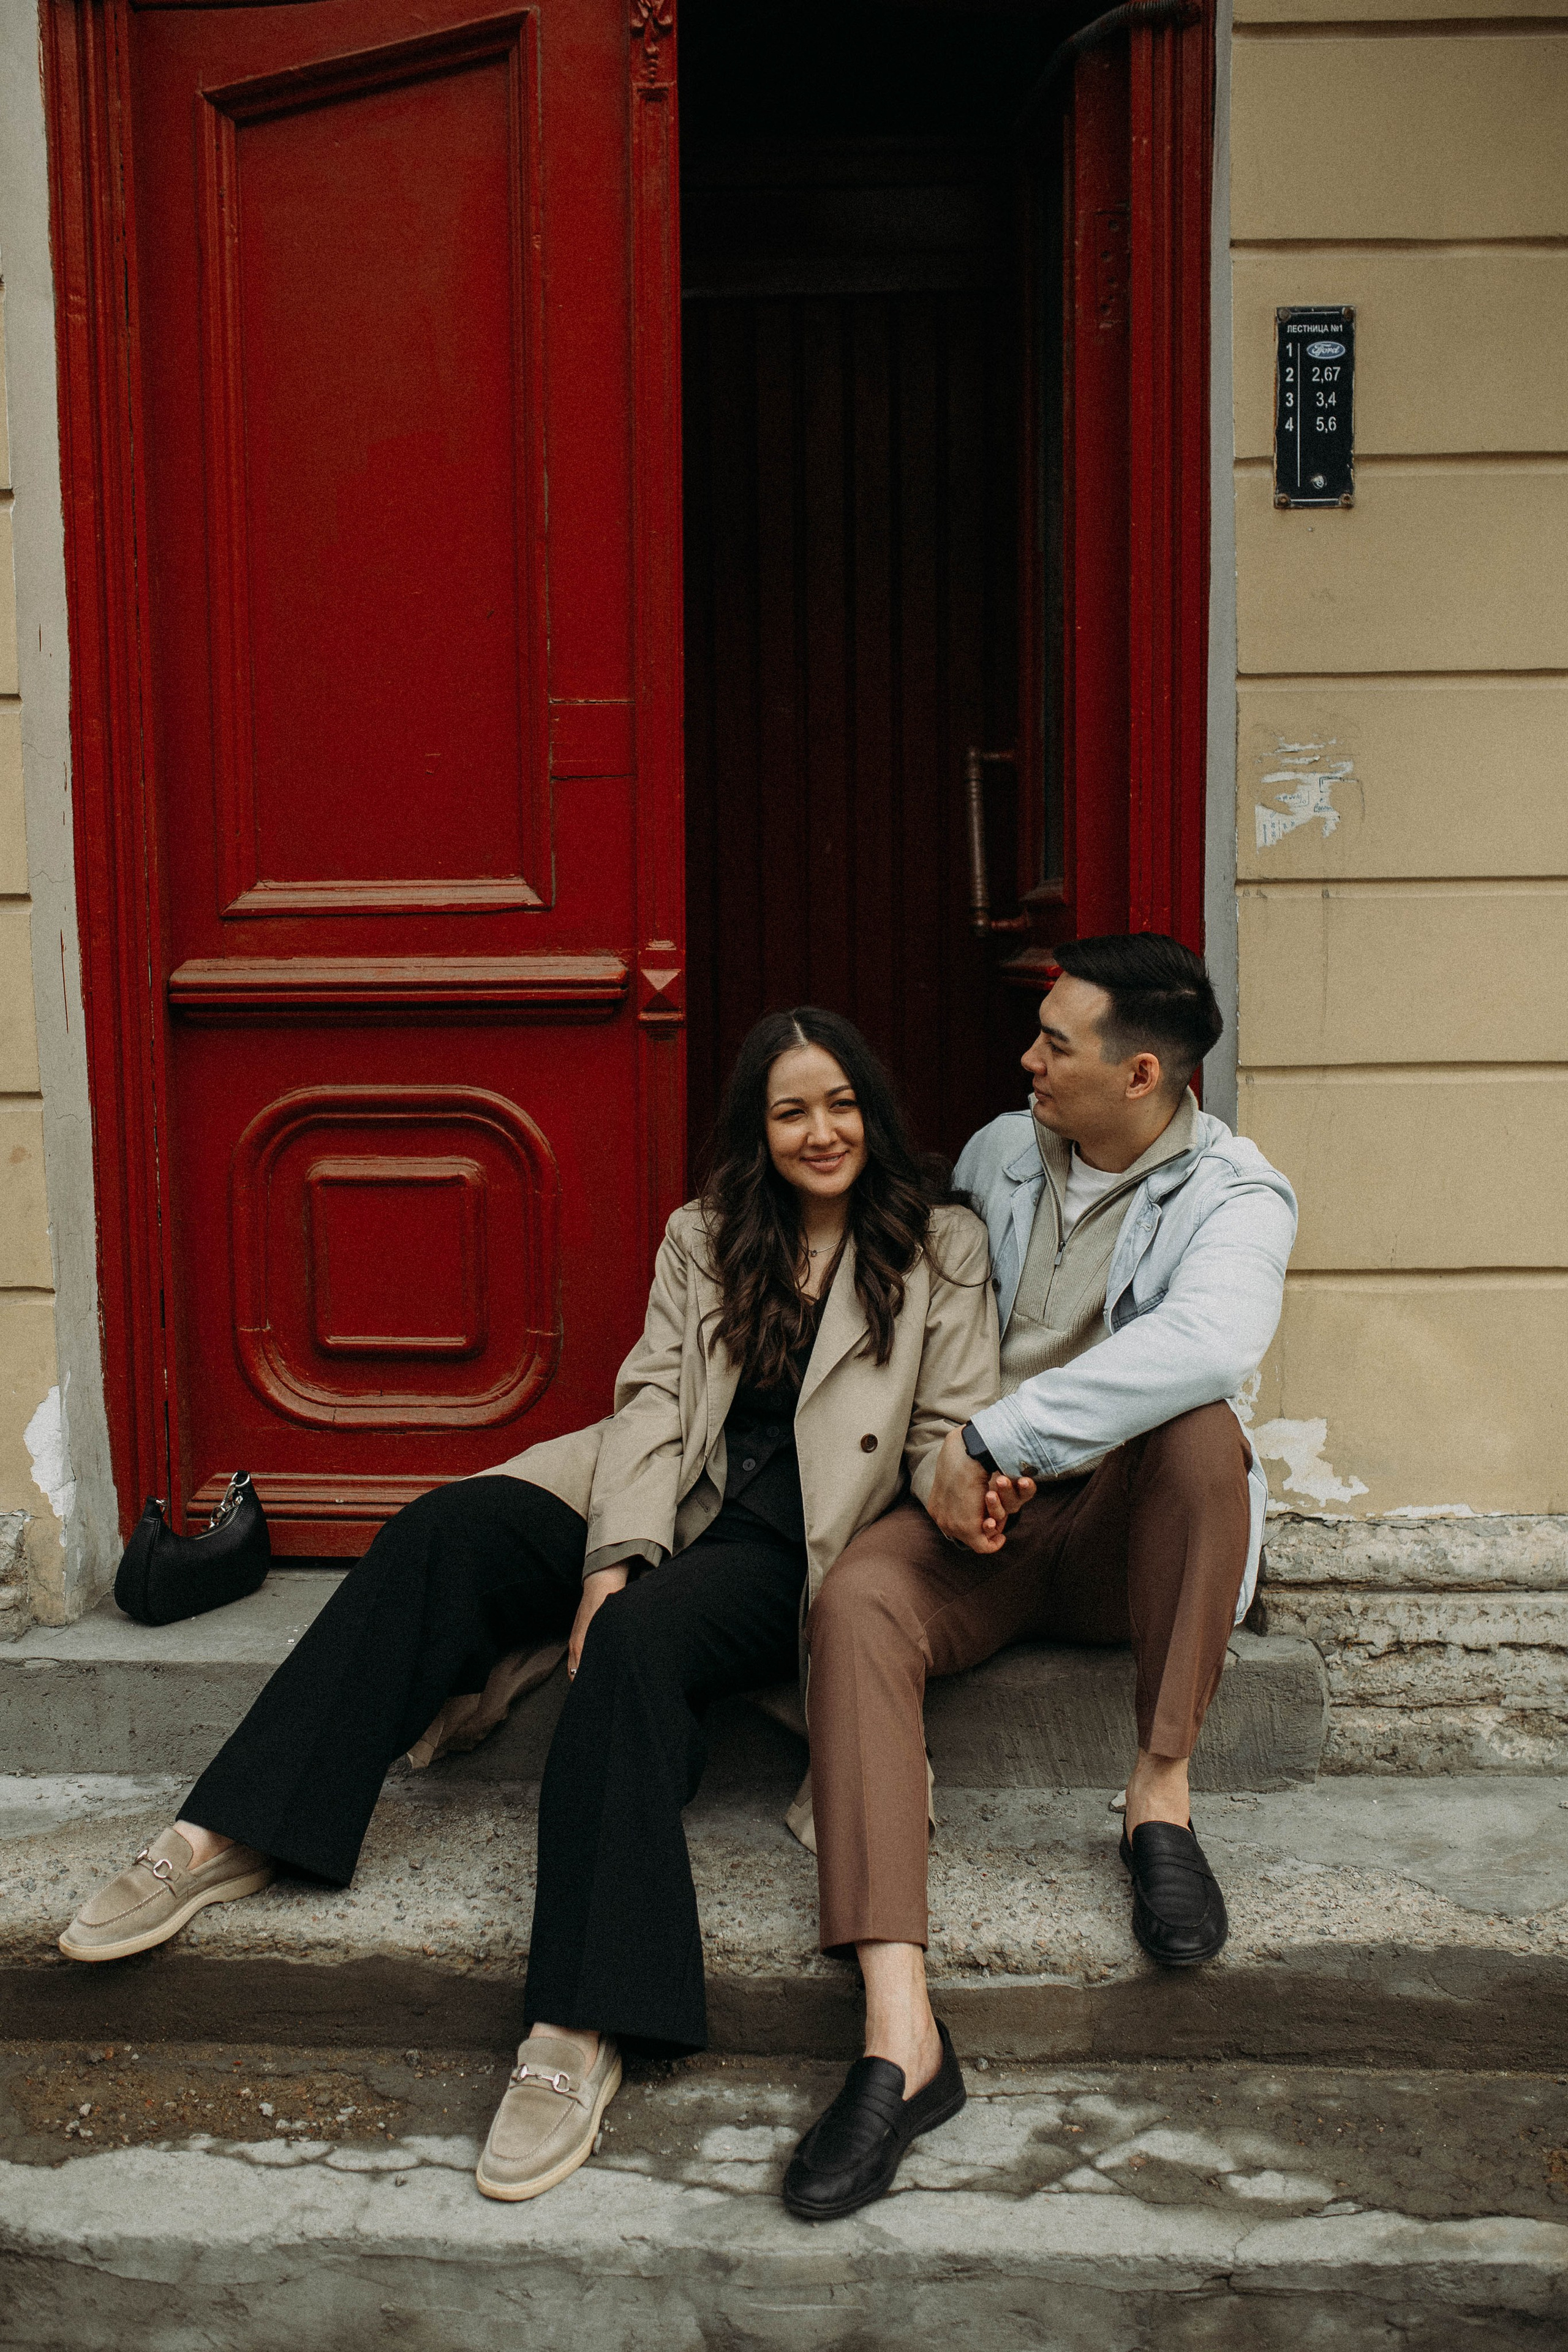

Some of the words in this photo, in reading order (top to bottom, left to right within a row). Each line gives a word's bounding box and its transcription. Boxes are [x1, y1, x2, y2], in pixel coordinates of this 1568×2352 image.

[1287, 325, 1329, 333] ЛЕСТНИЦА
[1286, 342, 1292, 357] 1
[1311, 343, 1341, 357] Ford
[1286, 368, 1294, 382] 2
[1312, 366, 1341, 383] 2,67
[1286, 392, 1294, 407] 3
[1316, 391, 1336, 409] 3,4
[1285, 417, 1294, 431] 4
[1316, 417, 1336, 433] 5,6
